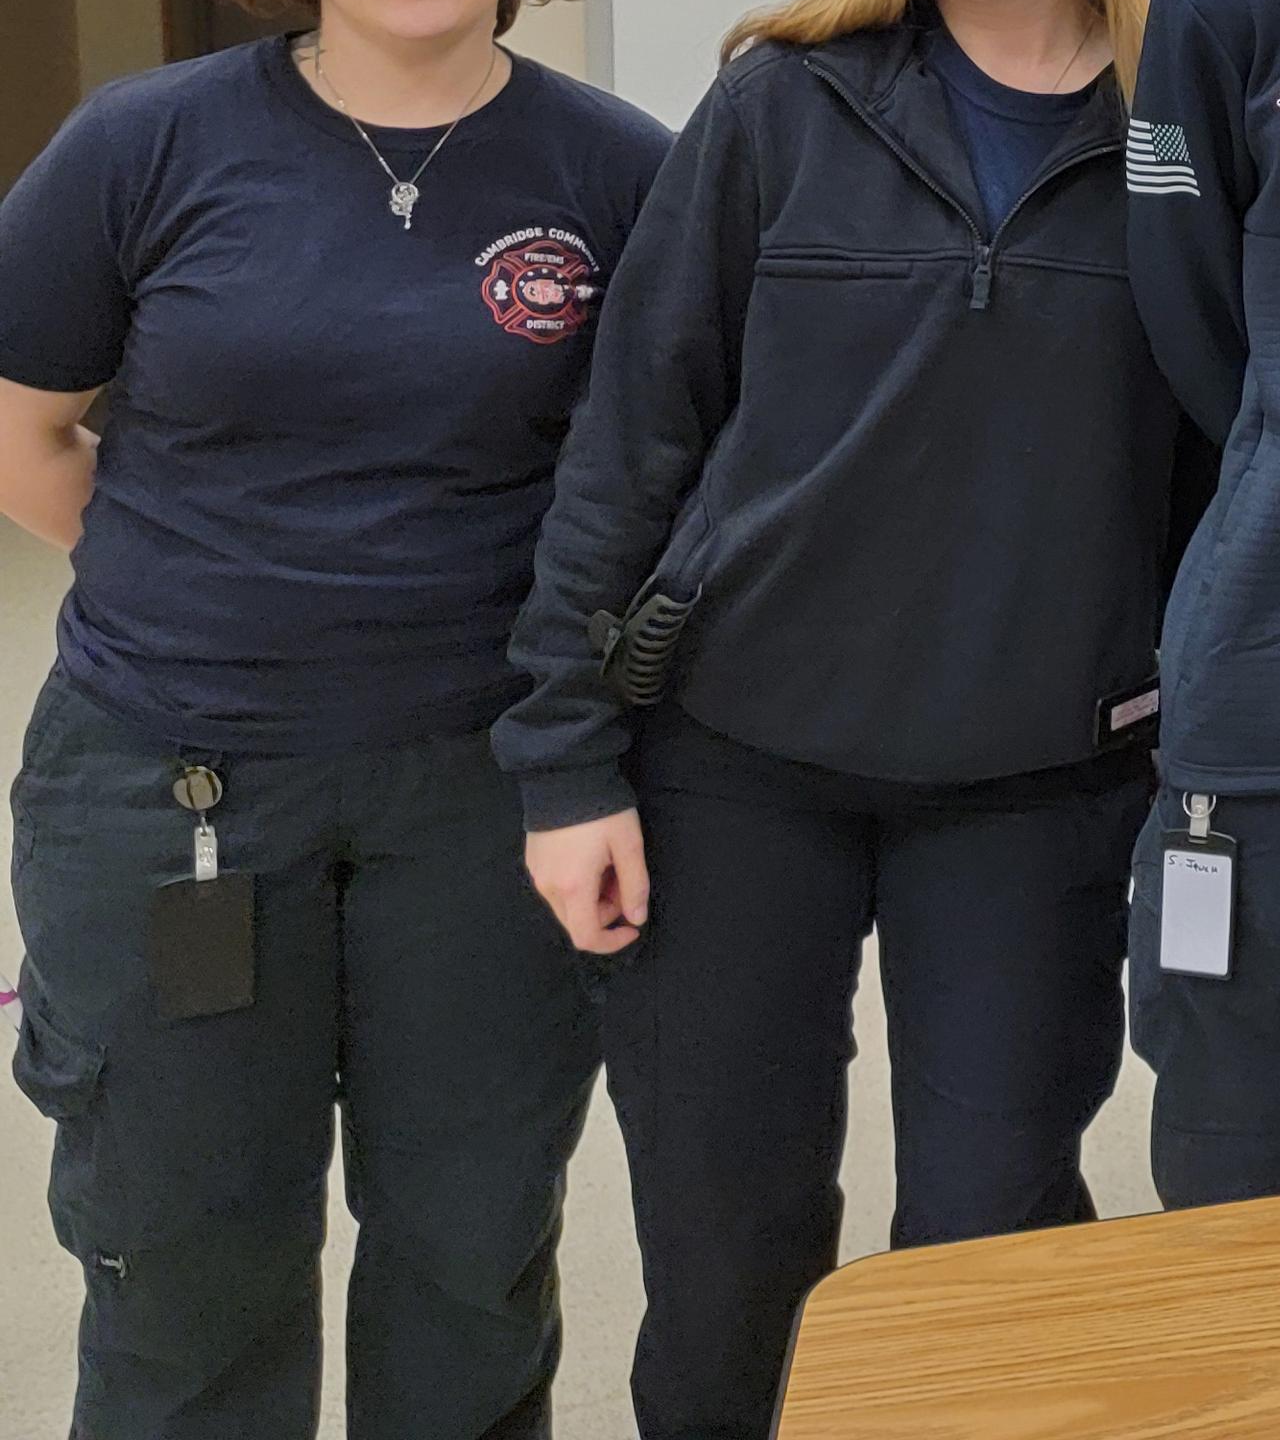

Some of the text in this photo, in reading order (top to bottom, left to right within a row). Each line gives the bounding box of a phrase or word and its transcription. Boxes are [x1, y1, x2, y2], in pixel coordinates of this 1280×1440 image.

[474, 226, 544, 268] CAMBRIDGE
[524, 252, 565, 265] FIRE/EMS
[526, 318, 565, 331] DISTRICT
